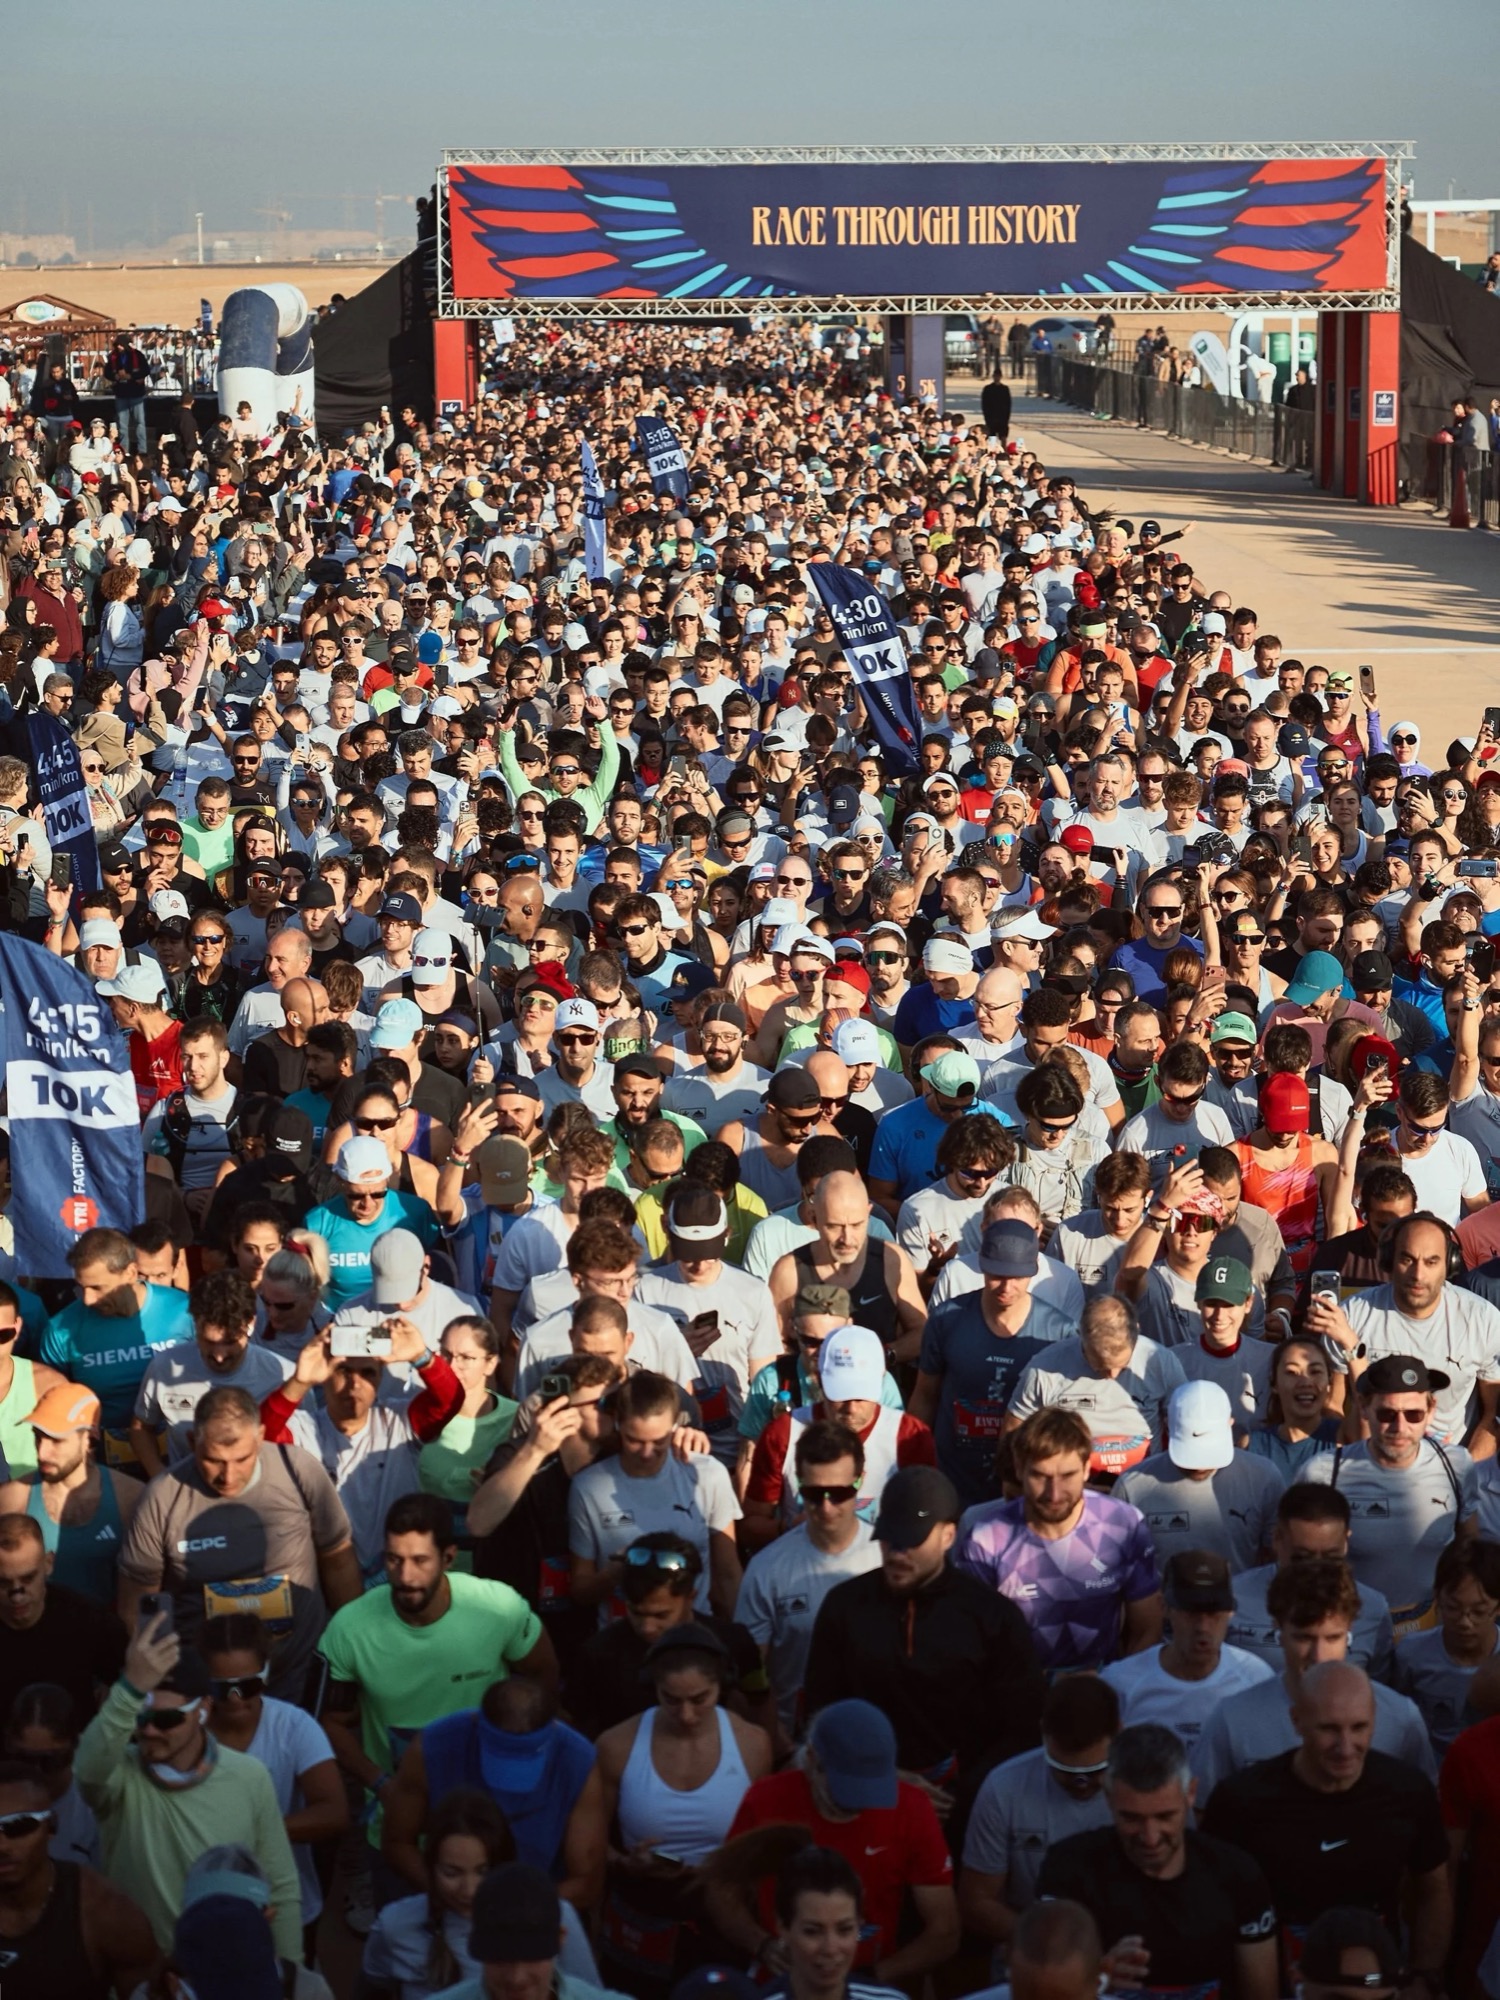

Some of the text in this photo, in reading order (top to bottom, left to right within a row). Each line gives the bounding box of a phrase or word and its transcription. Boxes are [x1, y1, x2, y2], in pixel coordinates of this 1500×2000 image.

[752, 204, 1081, 245] RACE THROUGH HISTORY
[919, 378, 937, 397] 5K
[645, 426, 671, 445] 5:15
[654, 454, 680, 472] 10K
[831, 594, 882, 625] 4:30
[854, 647, 898, 675] 0K
[37, 739, 75, 777] 4:45
[40, 769, 79, 796] min/km
[46, 801, 86, 837] 10K
[28, 996, 101, 1042] 4:15
[31, 1073, 116, 1117] 10K
[71, 1137, 86, 1195] FACTORY
[73, 1201, 88, 1227] TRI
[1215, 1266, 1228, 1284] G
